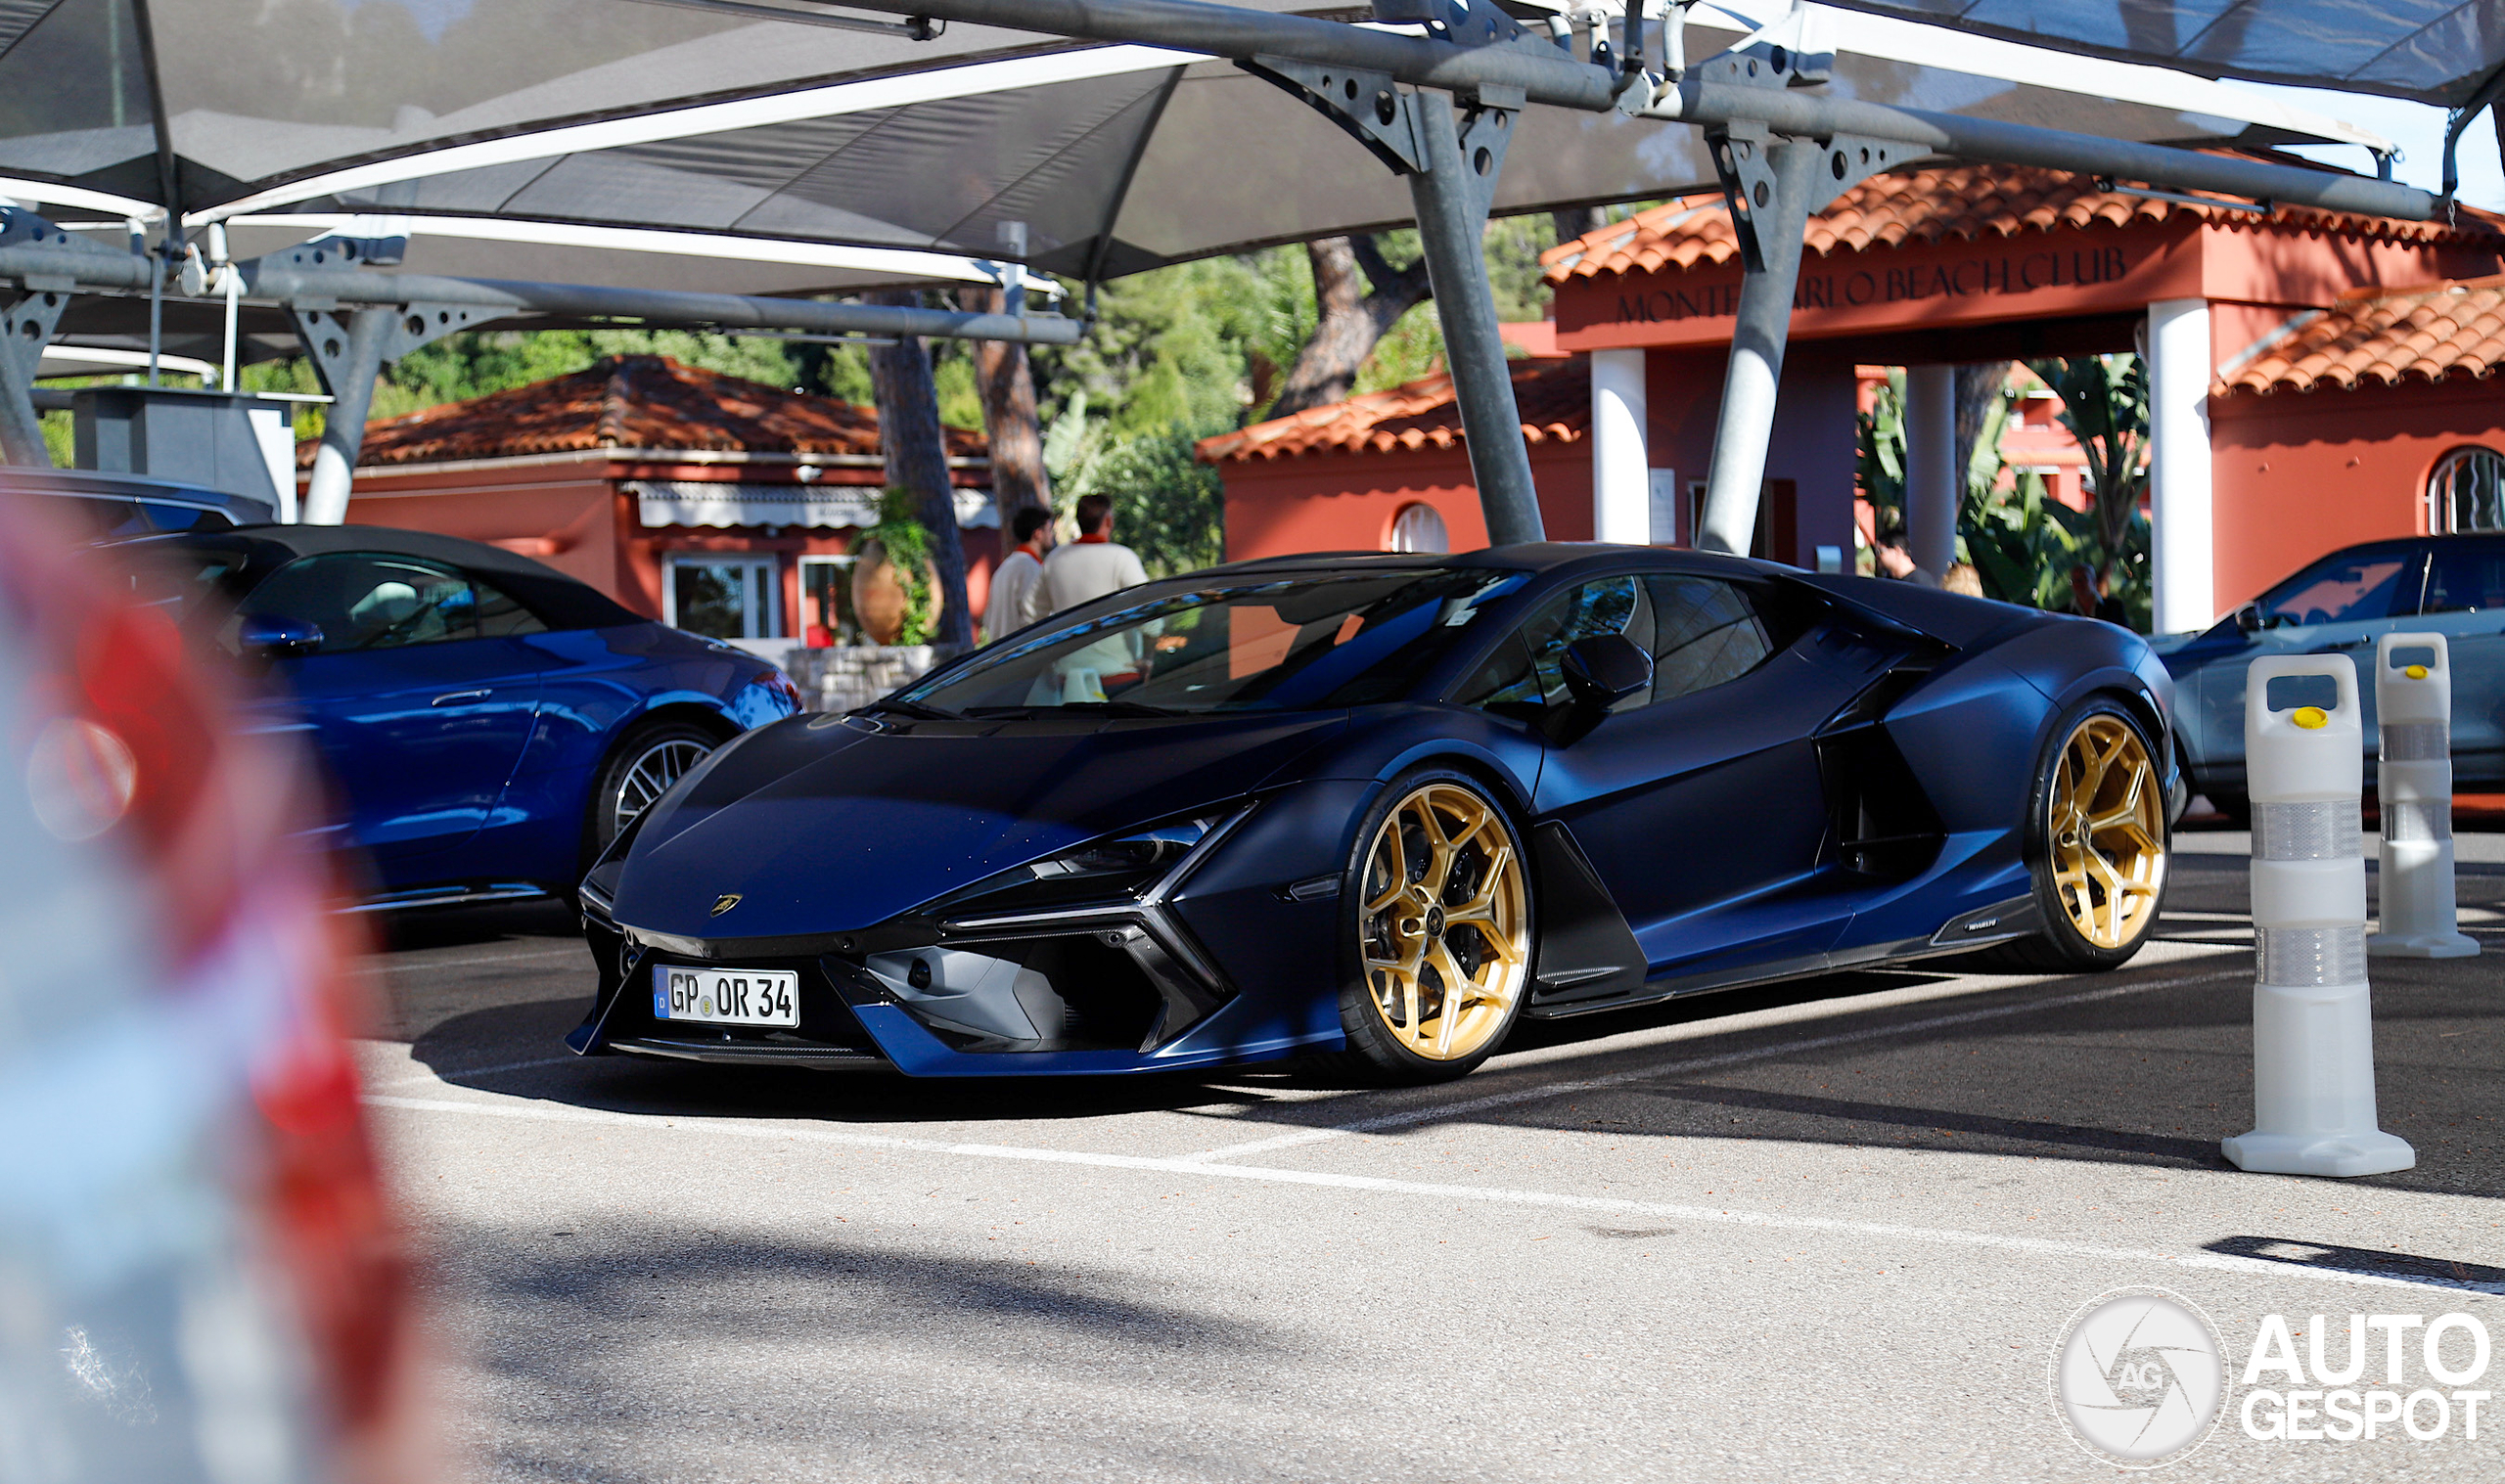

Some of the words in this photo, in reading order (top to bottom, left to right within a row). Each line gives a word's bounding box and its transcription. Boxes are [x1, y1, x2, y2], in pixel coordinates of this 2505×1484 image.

[1617, 284, 1742, 325] MONTE
[1794, 271, 1877, 310] RLO
[1887, 258, 2010, 301] BEACH
[2021, 247, 2126, 289] CLUB
[659, 997, 665, 1009] D
[670, 973, 699, 1013] GP
[717, 978, 750, 1017] OR
[757, 979, 792, 1018] 34
